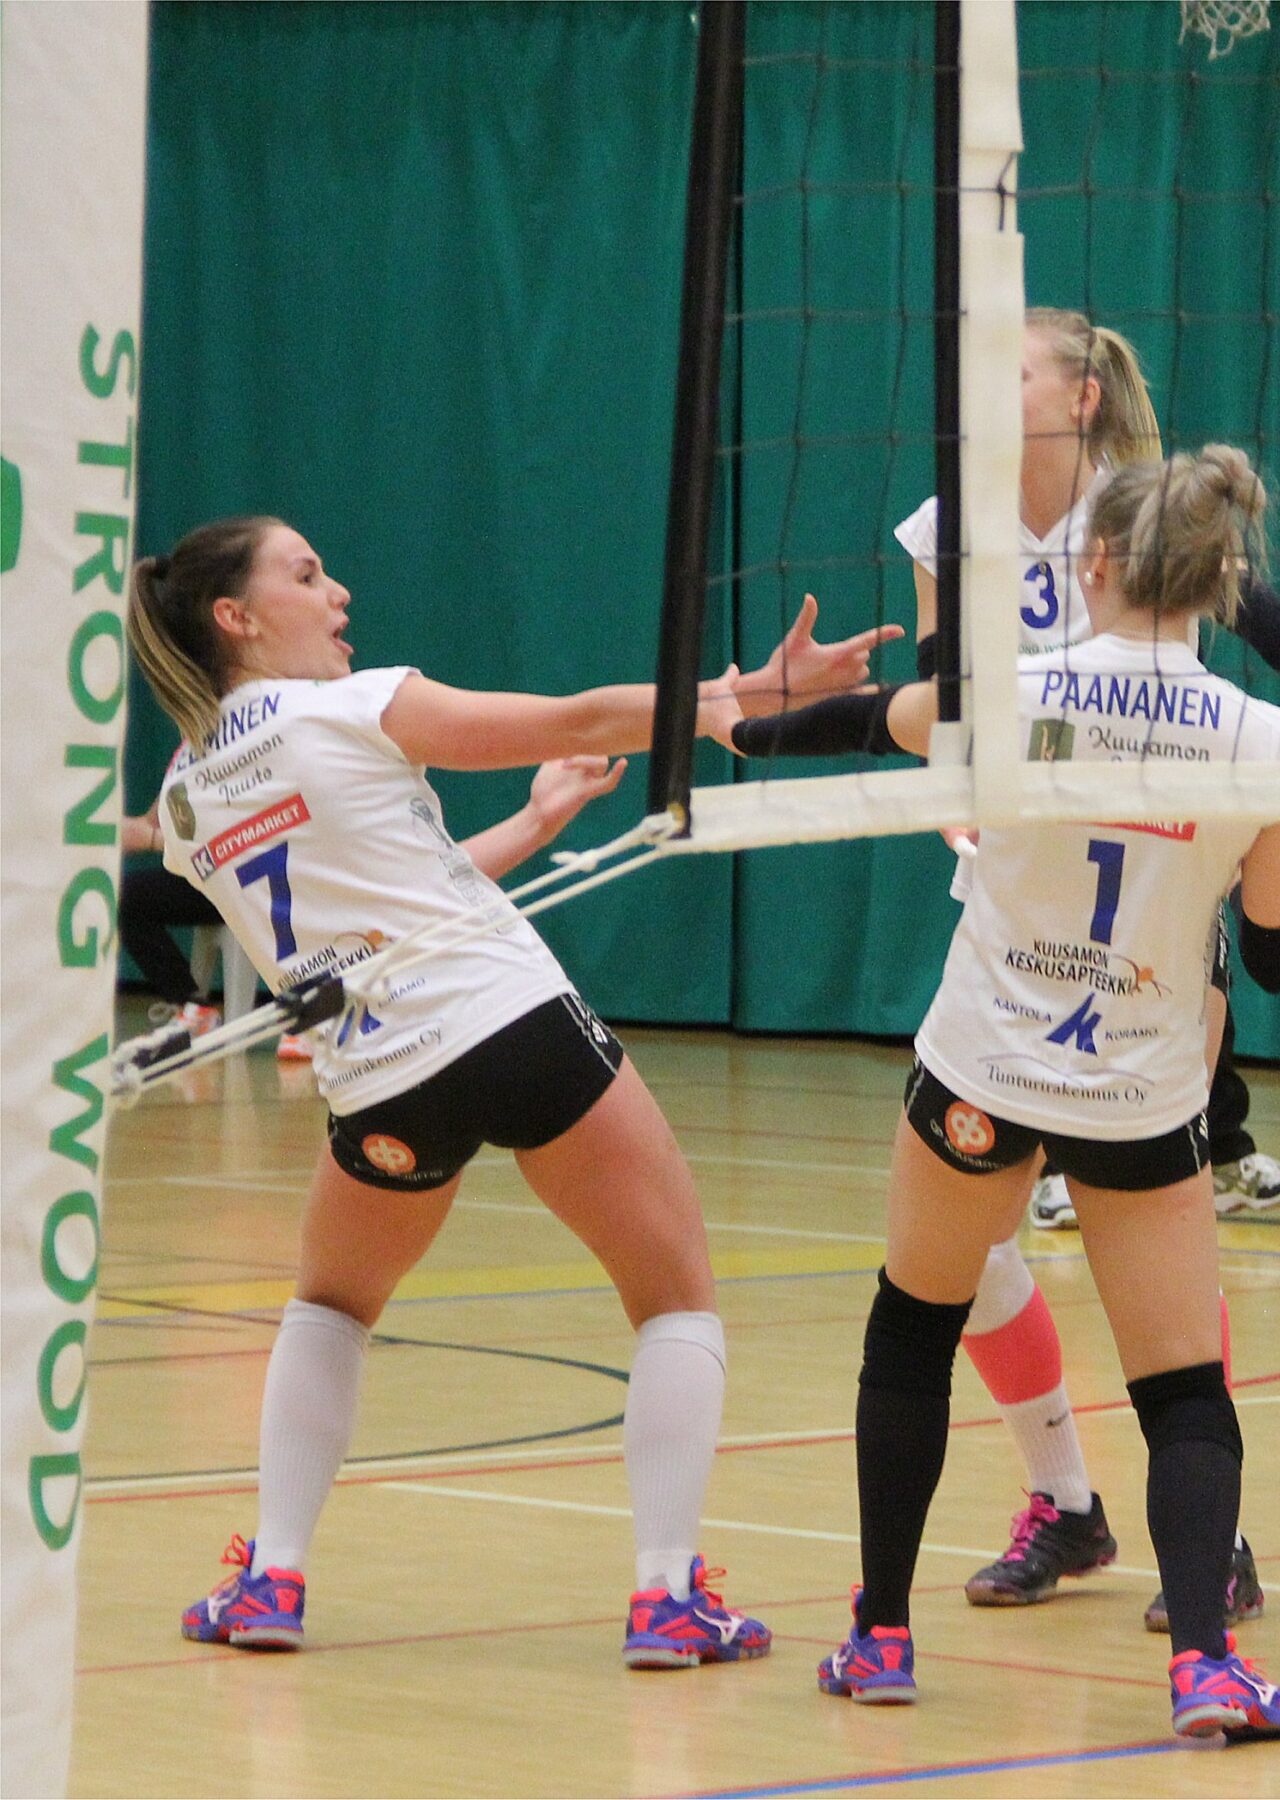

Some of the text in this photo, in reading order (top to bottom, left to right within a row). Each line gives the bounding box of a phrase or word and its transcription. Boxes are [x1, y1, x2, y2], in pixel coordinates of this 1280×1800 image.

[1020, 561, 1060, 629] 3
[1041, 670, 1222, 731] PAANANEN
[195, 733, 284, 789] Kuusamon
[1088, 726, 1211, 763] Kuusamon
[218, 766, 272, 806] Juusto
[215, 806, 301, 860] CITYMARKET
[235, 842, 297, 962] 7
[1087, 839, 1126, 946] 1
[28, 321, 137, 1551] STRONG WOOD
[1033, 939, 1109, 969] KUUSAMON
[1005, 950, 1135, 997] KESKUSAPTEEKKI
[993, 996, 1053, 1024] KANTOLA
[419, 1027, 443, 1047] Oy
[986, 1063, 1148, 1106] Tunturirakennus Oy
